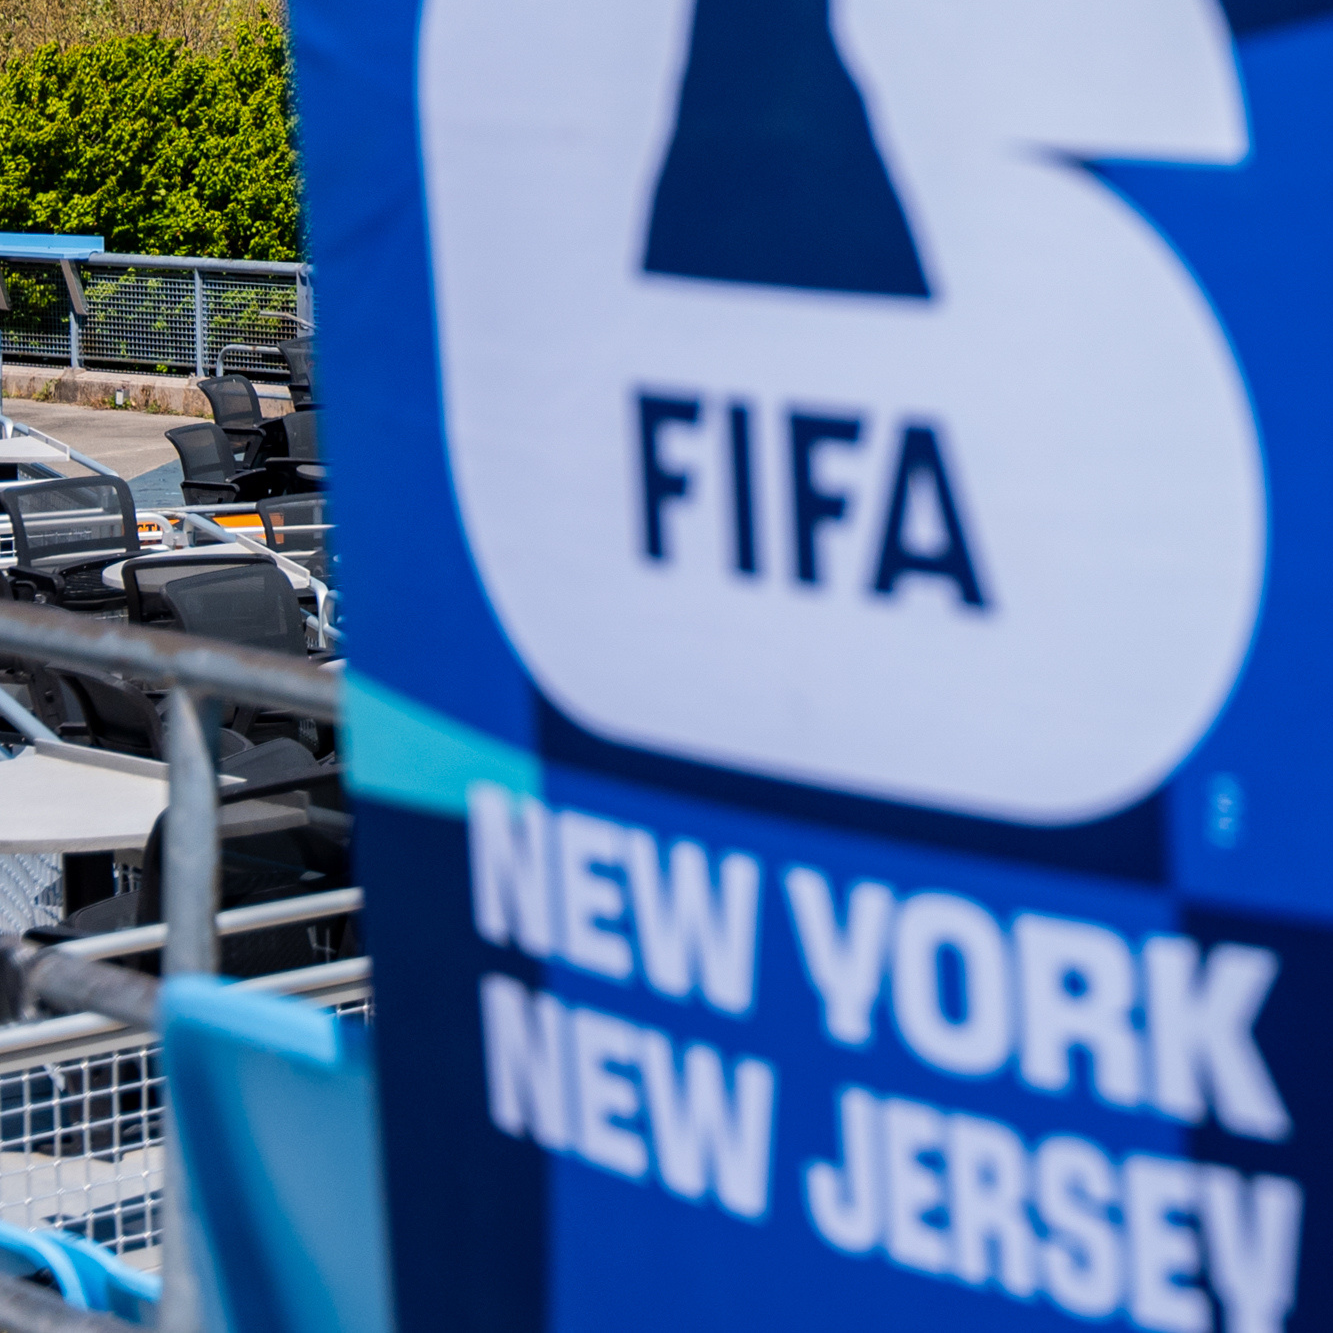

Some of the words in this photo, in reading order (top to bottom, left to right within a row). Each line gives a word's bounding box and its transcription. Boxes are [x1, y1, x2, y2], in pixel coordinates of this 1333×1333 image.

[630, 383, 996, 616] FIFA
[467, 778, 762, 1019] NEW
[785, 860, 1294, 1142] YORK
[479, 971, 774, 1222] NEW
[807, 1084, 1302, 1333] JERSEY
